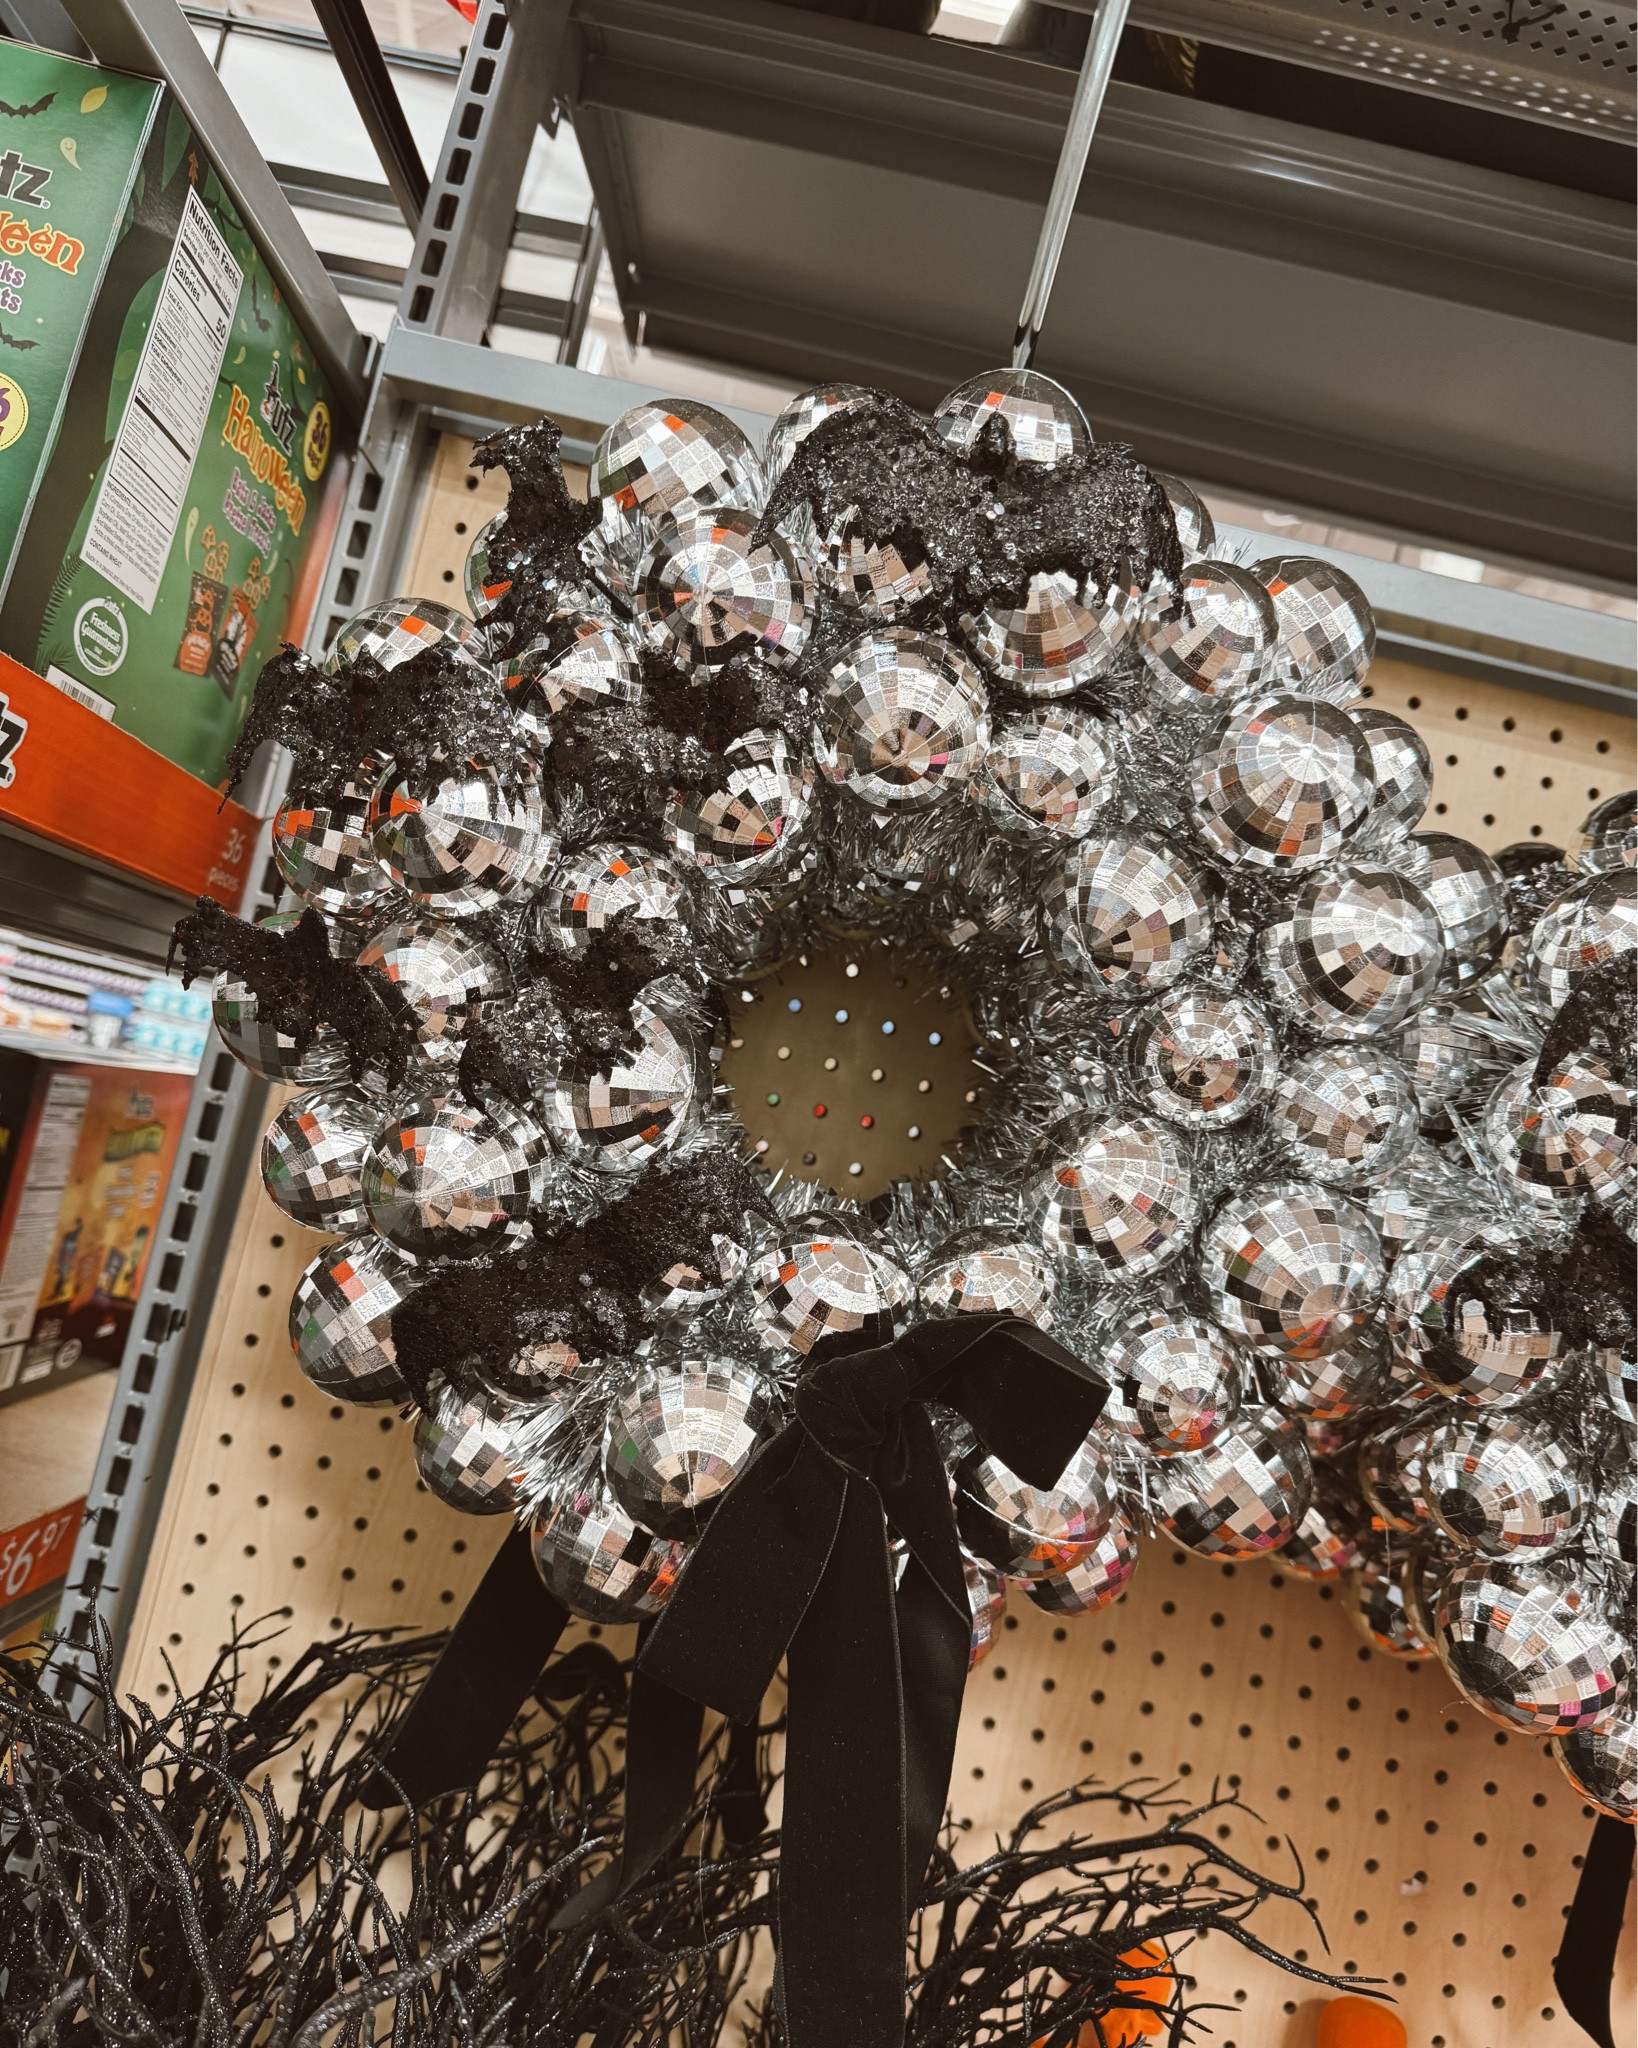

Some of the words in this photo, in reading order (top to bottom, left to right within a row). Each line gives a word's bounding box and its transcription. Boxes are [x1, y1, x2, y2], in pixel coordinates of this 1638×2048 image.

[0, 150, 53, 207] tz
[188, 199, 221, 259] Nutrition
[220, 251, 239, 290] Facts
[174, 257, 201, 303] Calories
[215, 316, 227, 340] 50
[156, 321, 177, 351] Cholesterol
[150, 343, 161, 359] Total
[160, 355, 182, 387] Carbohydrate
[222, 383, 307, 537] Halloween
[220, 827, 247, 865] 36
